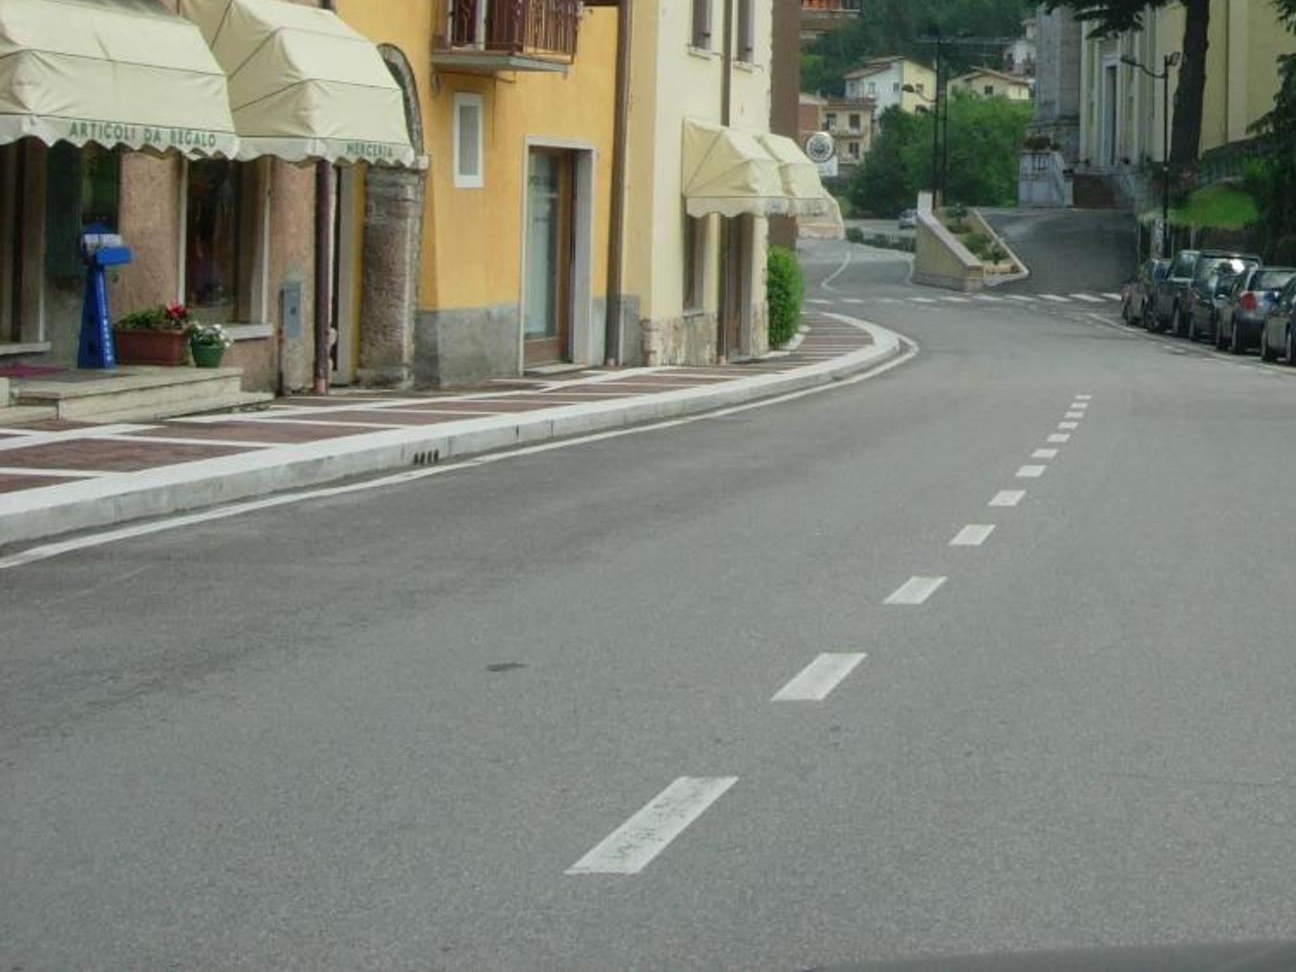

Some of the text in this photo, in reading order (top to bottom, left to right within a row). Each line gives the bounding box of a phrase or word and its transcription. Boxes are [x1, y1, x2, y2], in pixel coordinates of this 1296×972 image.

[69, 122, 216, 147] ARTICOLI DA REGALO
[346, 142, 393, 158] MERCERIA
